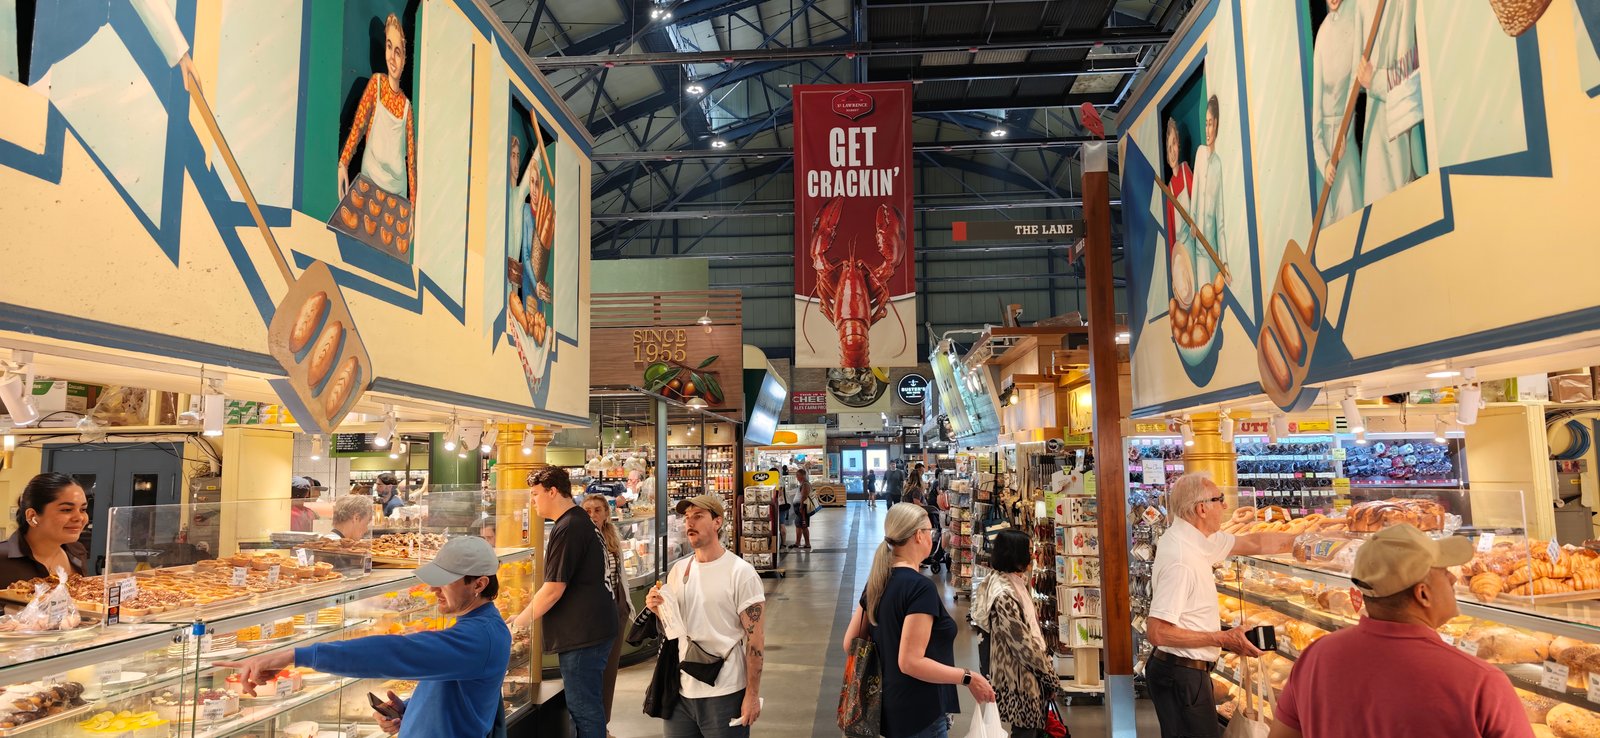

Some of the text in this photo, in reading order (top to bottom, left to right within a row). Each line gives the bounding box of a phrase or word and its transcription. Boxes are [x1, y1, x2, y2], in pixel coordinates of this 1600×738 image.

[829, 126, 877, 168] GET
[807, 167, 900, 198] CRACKIN'
[1014, 224, 1073, 235] THE LANE
[633, 328, 687, 344] SINCE
[633, 343, 687, 363] 1955
[792, 395, 826, 403] CHEE
